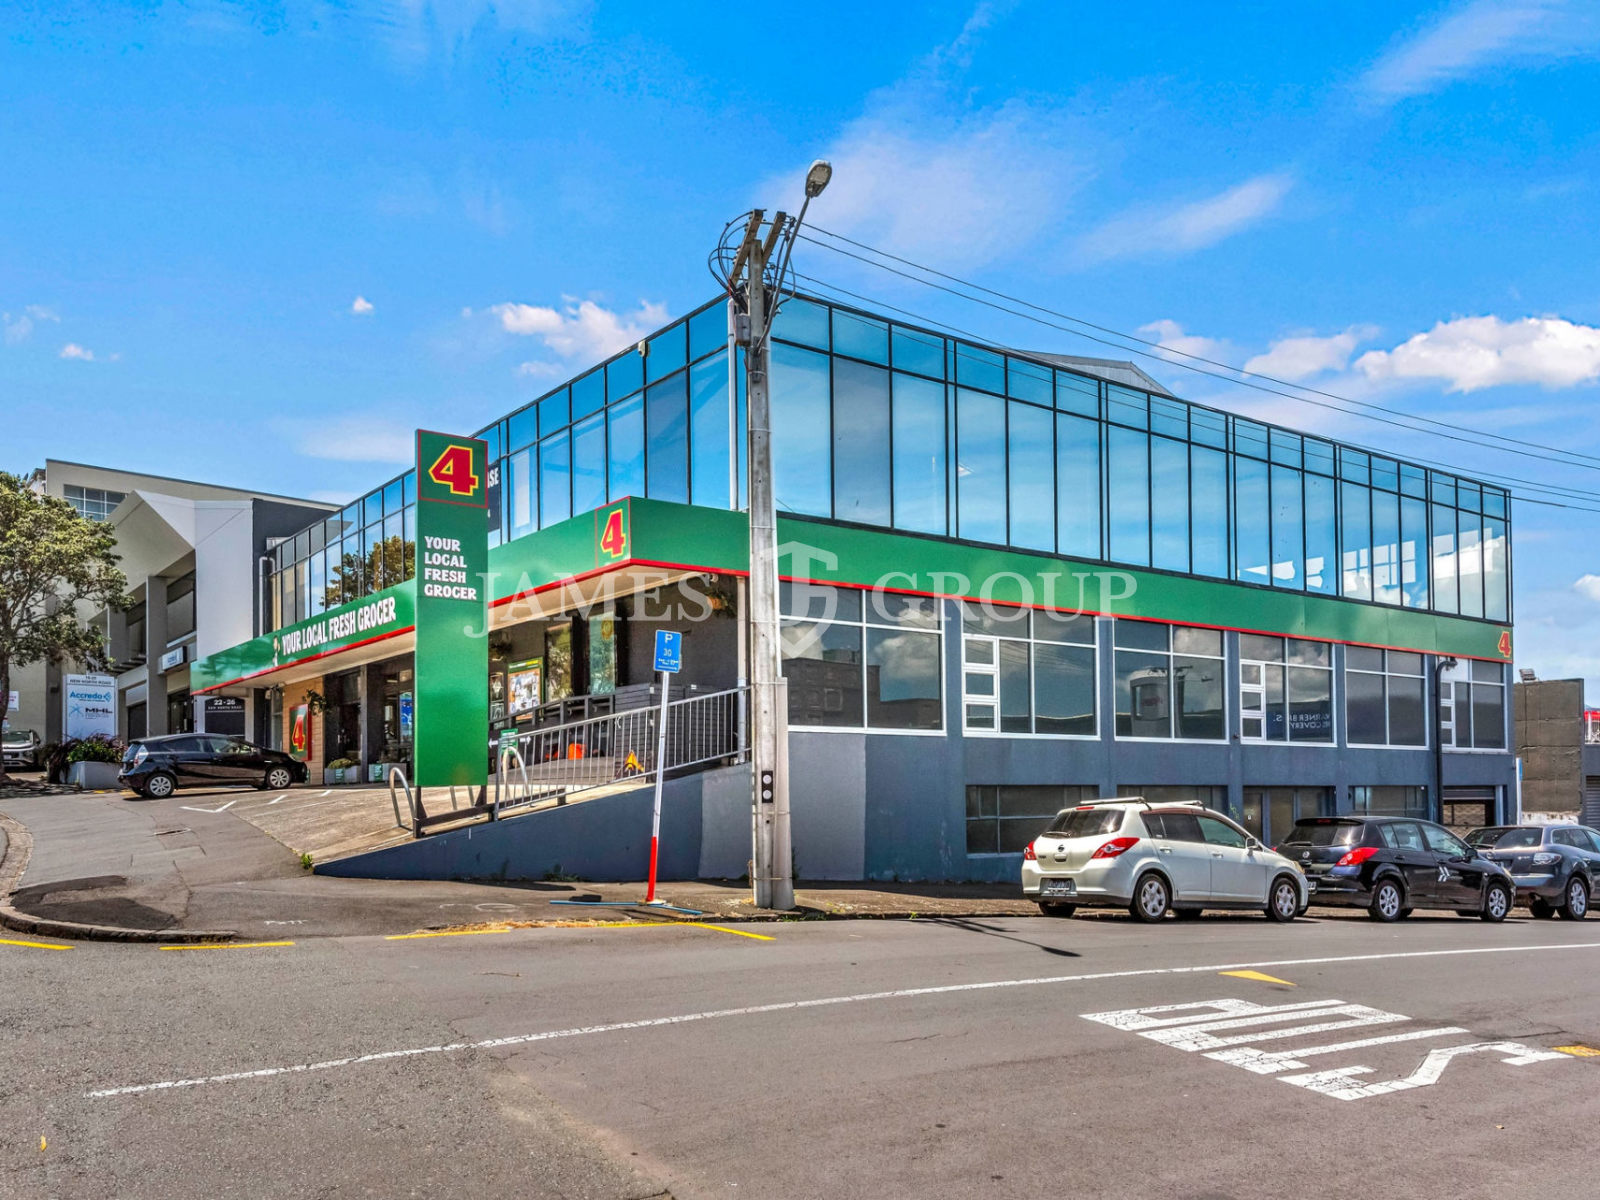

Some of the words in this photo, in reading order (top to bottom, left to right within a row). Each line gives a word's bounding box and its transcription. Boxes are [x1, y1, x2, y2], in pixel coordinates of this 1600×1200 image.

[428, 444, 479, 496] 4
[600, 508, 626, 558] 4
[424, 535, 460, 552] YOUR
[424, 552, 467, 568] LOCAL
[424, 567, 466, 584] FRESH
[424, 583, 477, 600] GROCER
[282, 630, 302, 656] YOUR
[302, 620, 328, 650] LOCAL
[328, 610, 357, 641] FRESH
[357, 596, 397, 632] GROCER
[664, 633, 673, 643] P
[1498, 631, 1511, 657] 4
[69, 691, 103, 700] Accredo
[292, 714, 305, 752] 4
